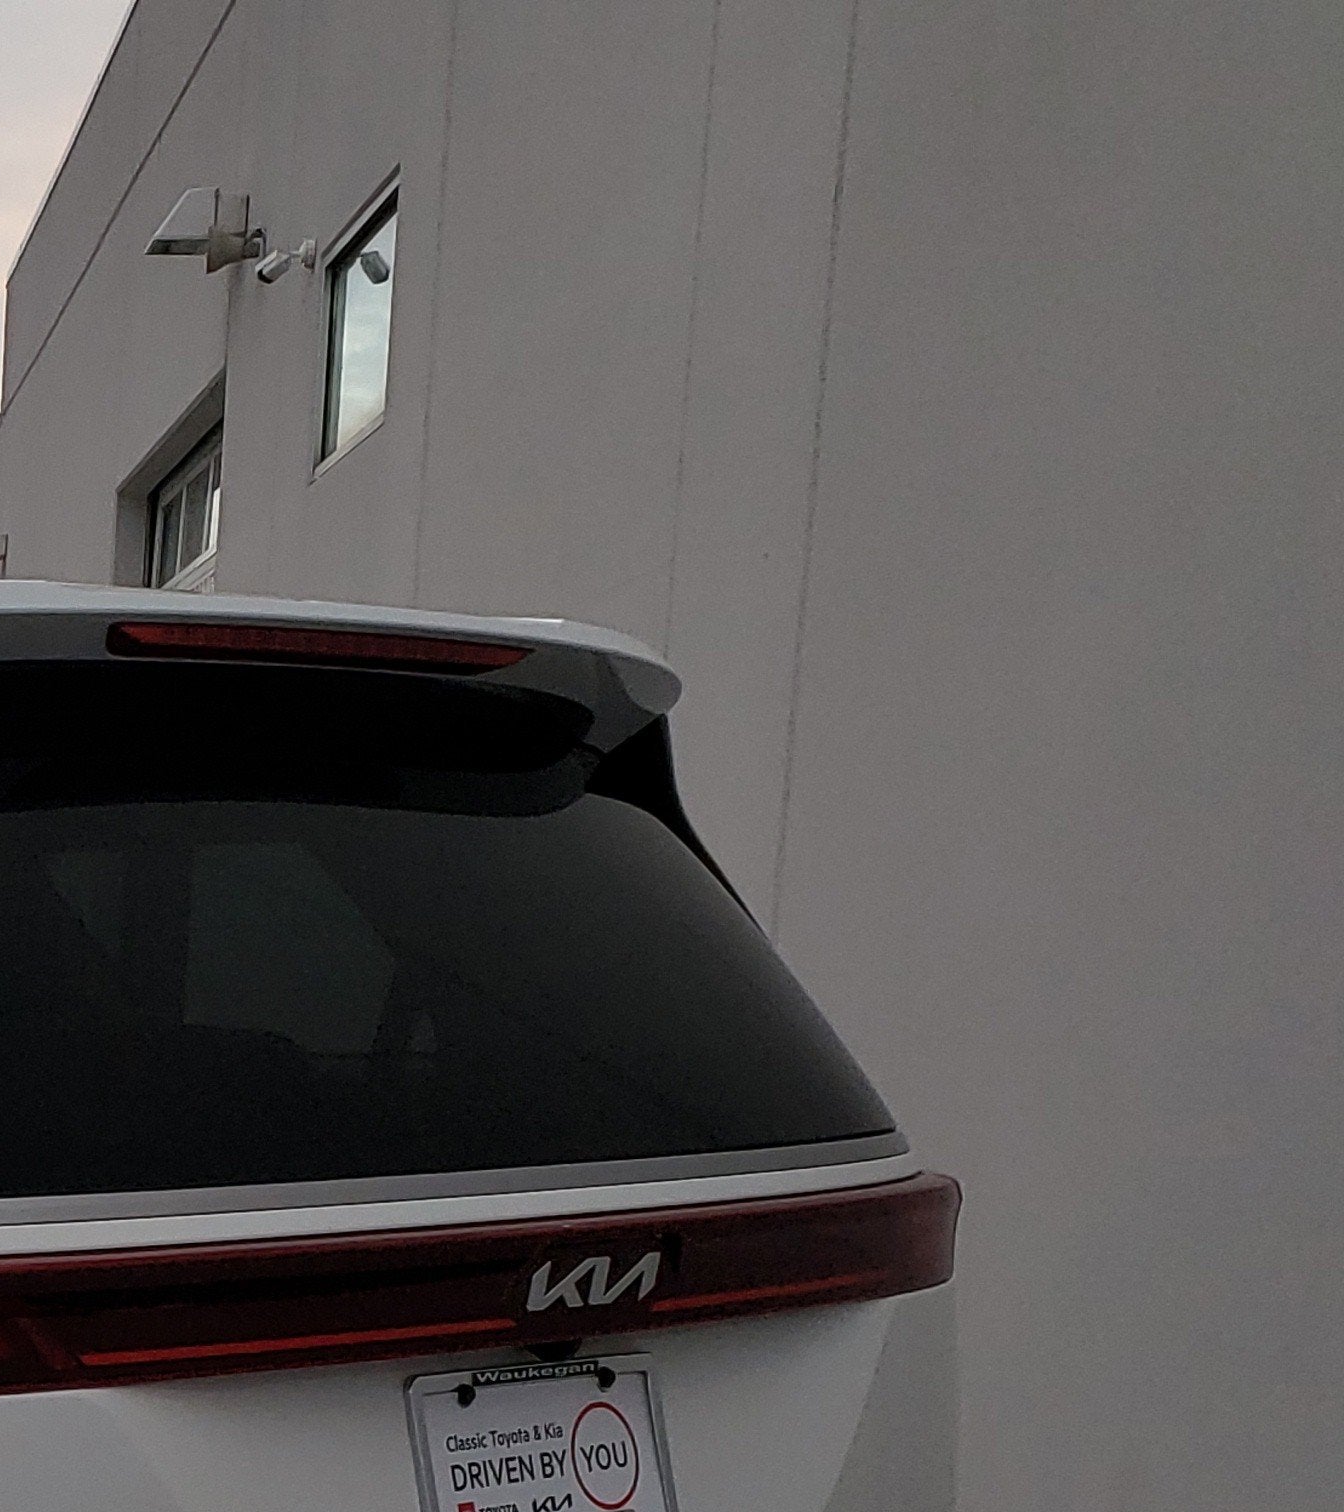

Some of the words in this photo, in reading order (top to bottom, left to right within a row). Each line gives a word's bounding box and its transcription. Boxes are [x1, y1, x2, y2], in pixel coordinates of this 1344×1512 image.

[526, 1252, 661, 1312] KIA
[475, 1361, 595, 1384] Waukegan
[446, 1432, 487, 1452] Classic
[489, 1427, 530, 1448] Toyota
[533, 1426, 541, 1440] &
[544, 1423, 564, 1439] Kia
[450, 1455, 535, 1491] DRIVEN
[540, 1450, 567, 1478] BY
[580, 1441, 628, 1472] YOU
